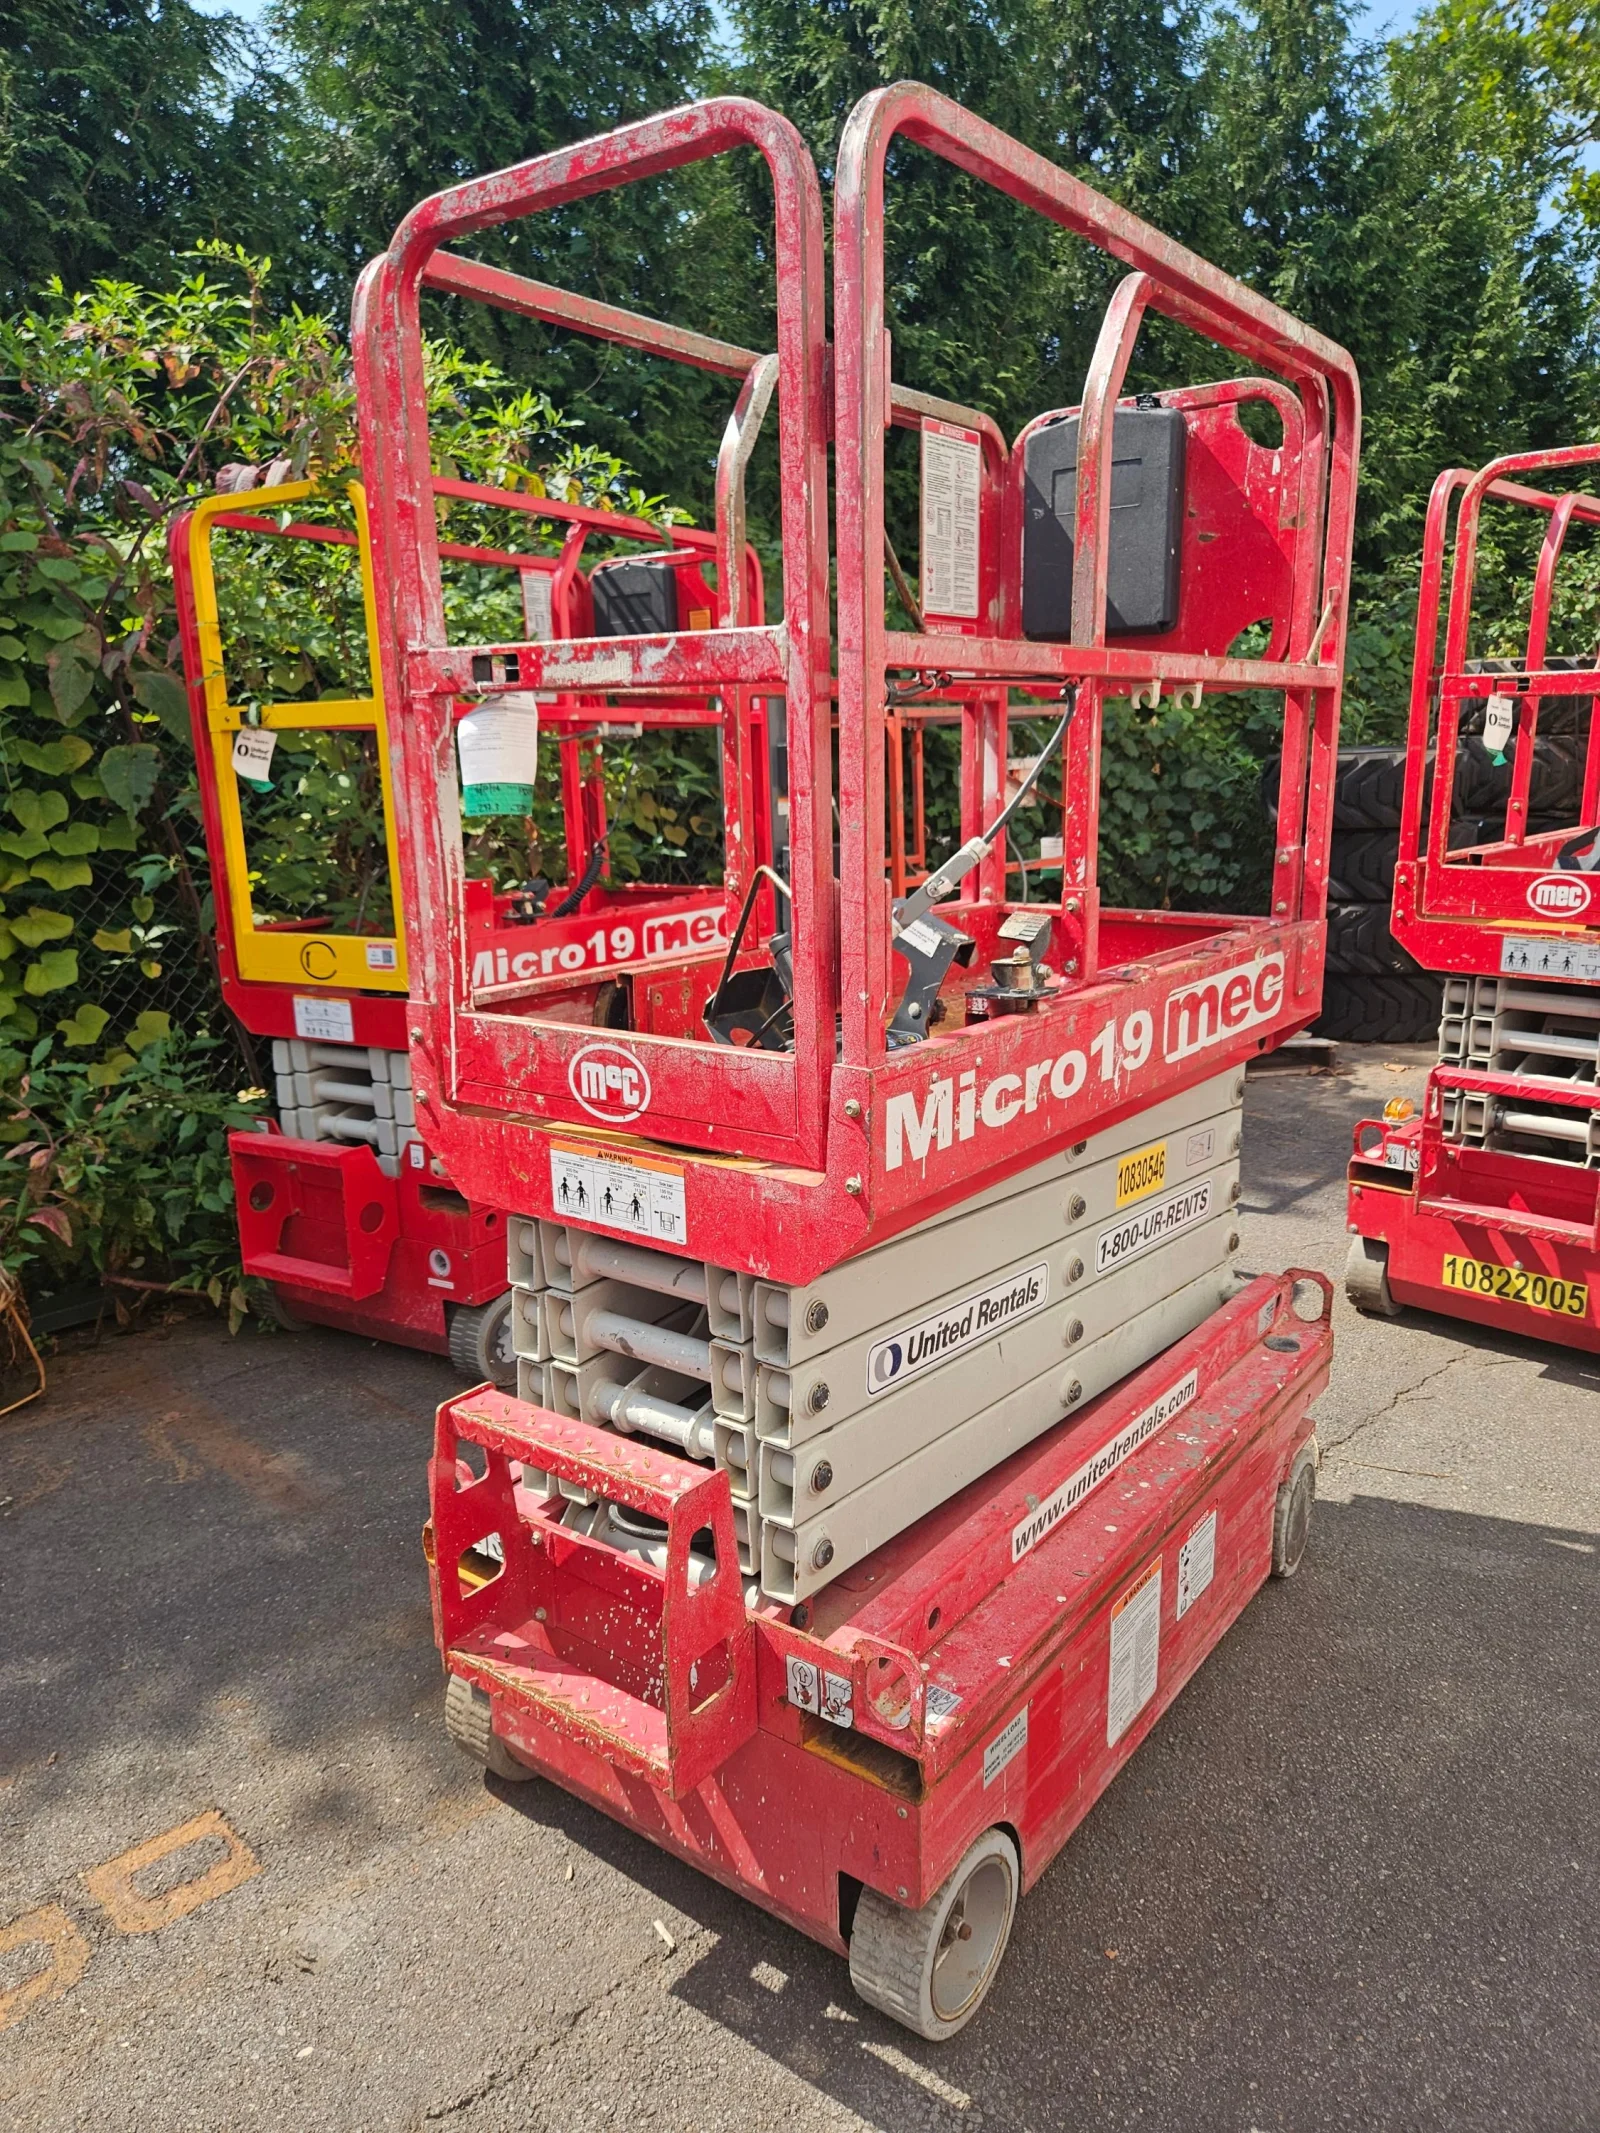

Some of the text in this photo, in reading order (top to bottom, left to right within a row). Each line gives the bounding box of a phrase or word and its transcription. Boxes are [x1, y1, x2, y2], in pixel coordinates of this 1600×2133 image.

[1535, 884, 1582, 908] mec
[885, 962, 1283, 1172] Micro19 mec
[603, 1151, 633, 1164] WARNING
[1118, 1150, 1165, 1197] 10830546
[1101, 1188, 1208, 1264] 1-800-UR-RENTS
[1446, 1257, 1586, 1314] 10822005
[907, 1276, 1039, 1365] United Rentals
[1015, 1379, 1195, 1555] www.unitedrentals.com
